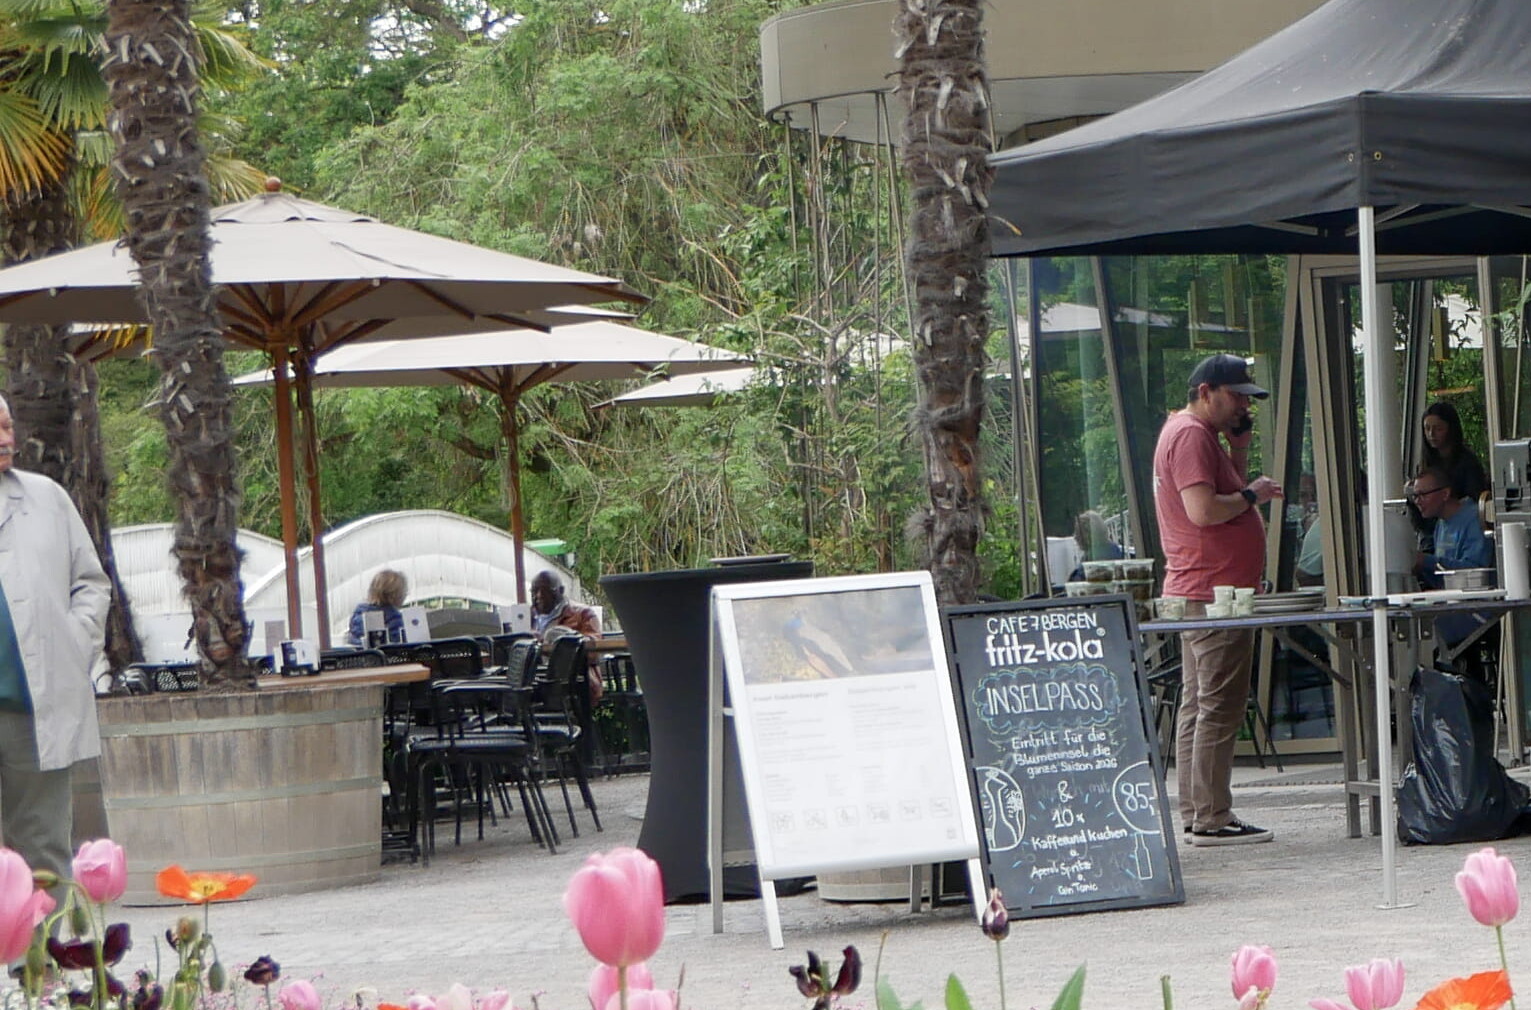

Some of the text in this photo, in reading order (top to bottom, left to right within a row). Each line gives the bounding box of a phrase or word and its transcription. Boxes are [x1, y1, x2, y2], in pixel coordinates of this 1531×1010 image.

[985, 629, 1104, 666] fritz-kola
[986, 682, 1104, 716] INSELPASS
[1011, 727, 1107, 750] Eintritt für die
[1013, 743, 1111, 766] Blumeninsel die
[1027, 763, 1059, 779] ganze
[1060, 760, 1094, 772] Saison
[1057, 780, 1074, 803] &
[1087, 825, 1128, 842] Kuchen
[1030, 861, 1059, 880] Aperol
[1057, 882, 1098, 895] Gin Tonic
